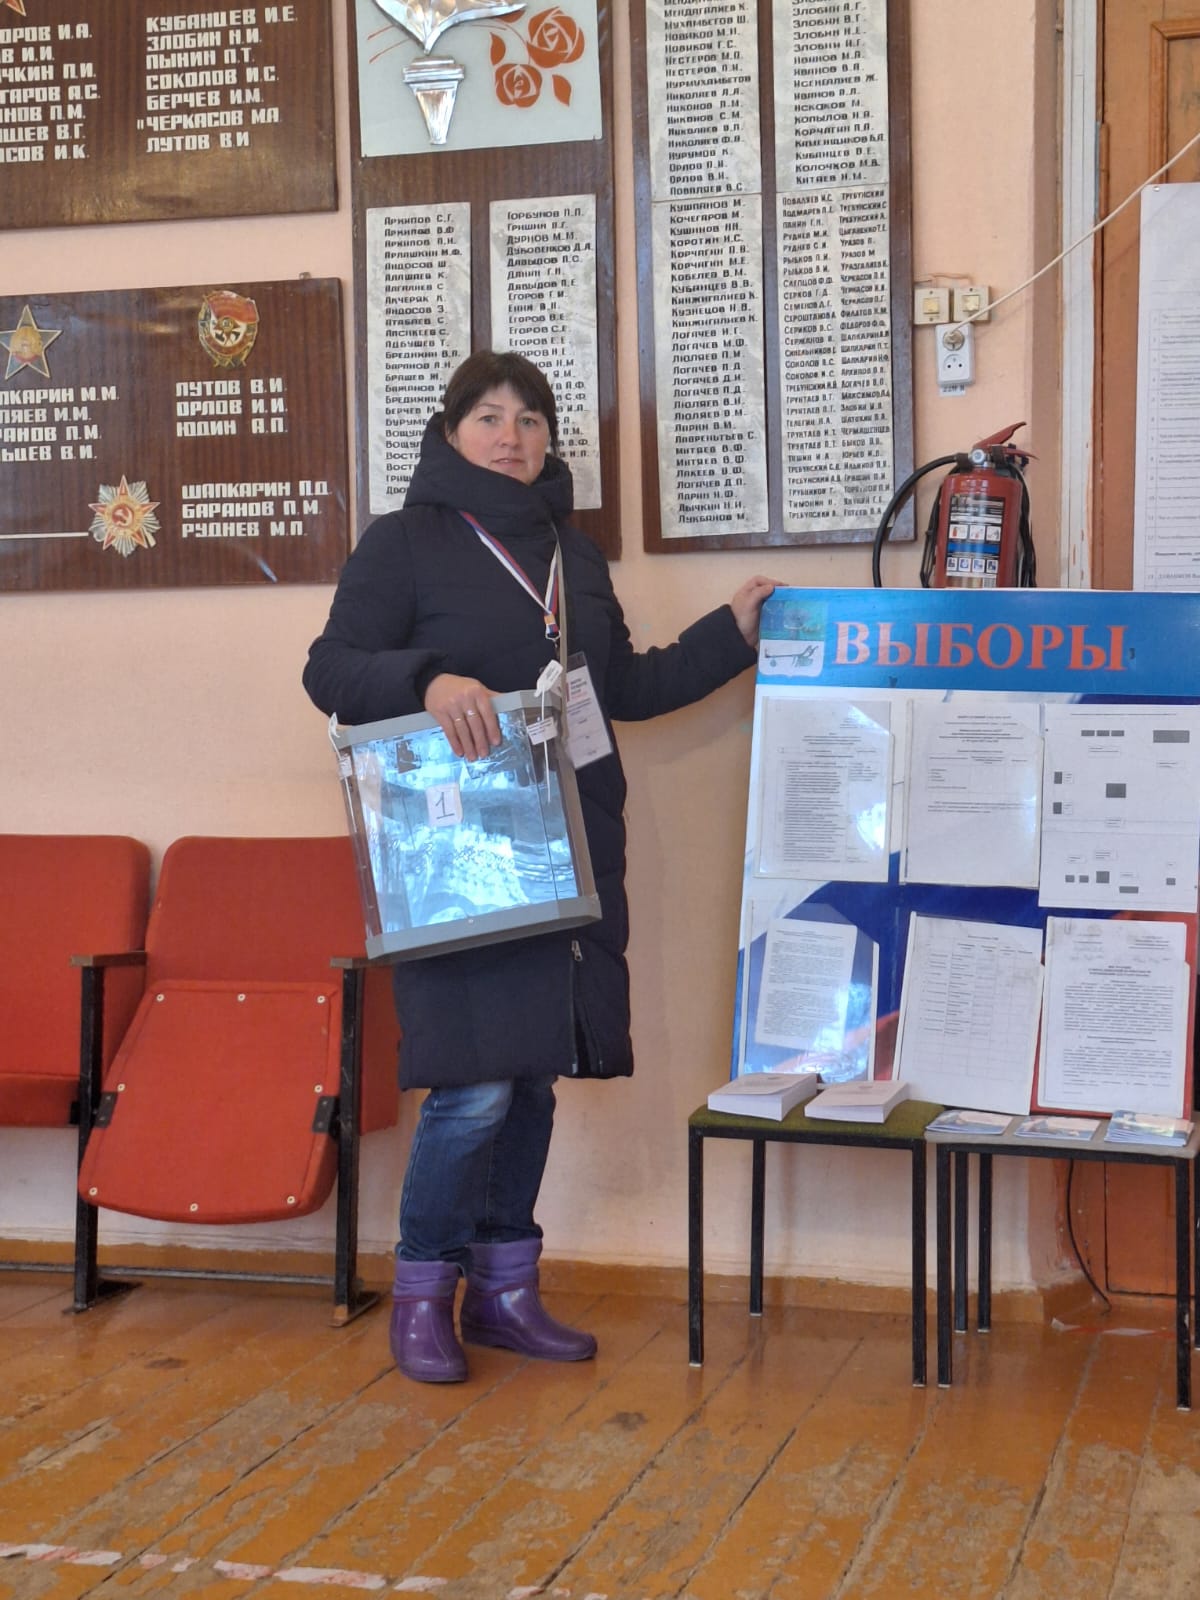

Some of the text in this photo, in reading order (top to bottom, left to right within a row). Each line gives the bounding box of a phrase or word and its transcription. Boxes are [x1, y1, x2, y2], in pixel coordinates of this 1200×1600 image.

[146, 9, 256, 32] КУБАНЦЕВ
[147, 31, 221, 51] ЗЛОБИН
[0, 49, 14, 63] В
[0, 65, 54, 83] ЧКИН
[146, 69, 237, 90] СОКОЛОВ
[147, 91, 220, 110] БЕРЧЕВ
[0, 106, 42, 123] НОВ
[146, 134, 210, 153] ЛУТОВ
[177, 400, 242, 416] ОРЛОВ
[0, 427, 57, 442] АНОВ
[177, 420, 236, 437] ЮДИН
[182, 482, 291, 499] ШАПКАРИН
[182, 501, 274, 518] БАРАНОВ
[182, 522, 260, 538] РУДНЕВ
[834, 621, 1128, 671] ВЫБОРЫ
[434, 791, 455, 819] 1
